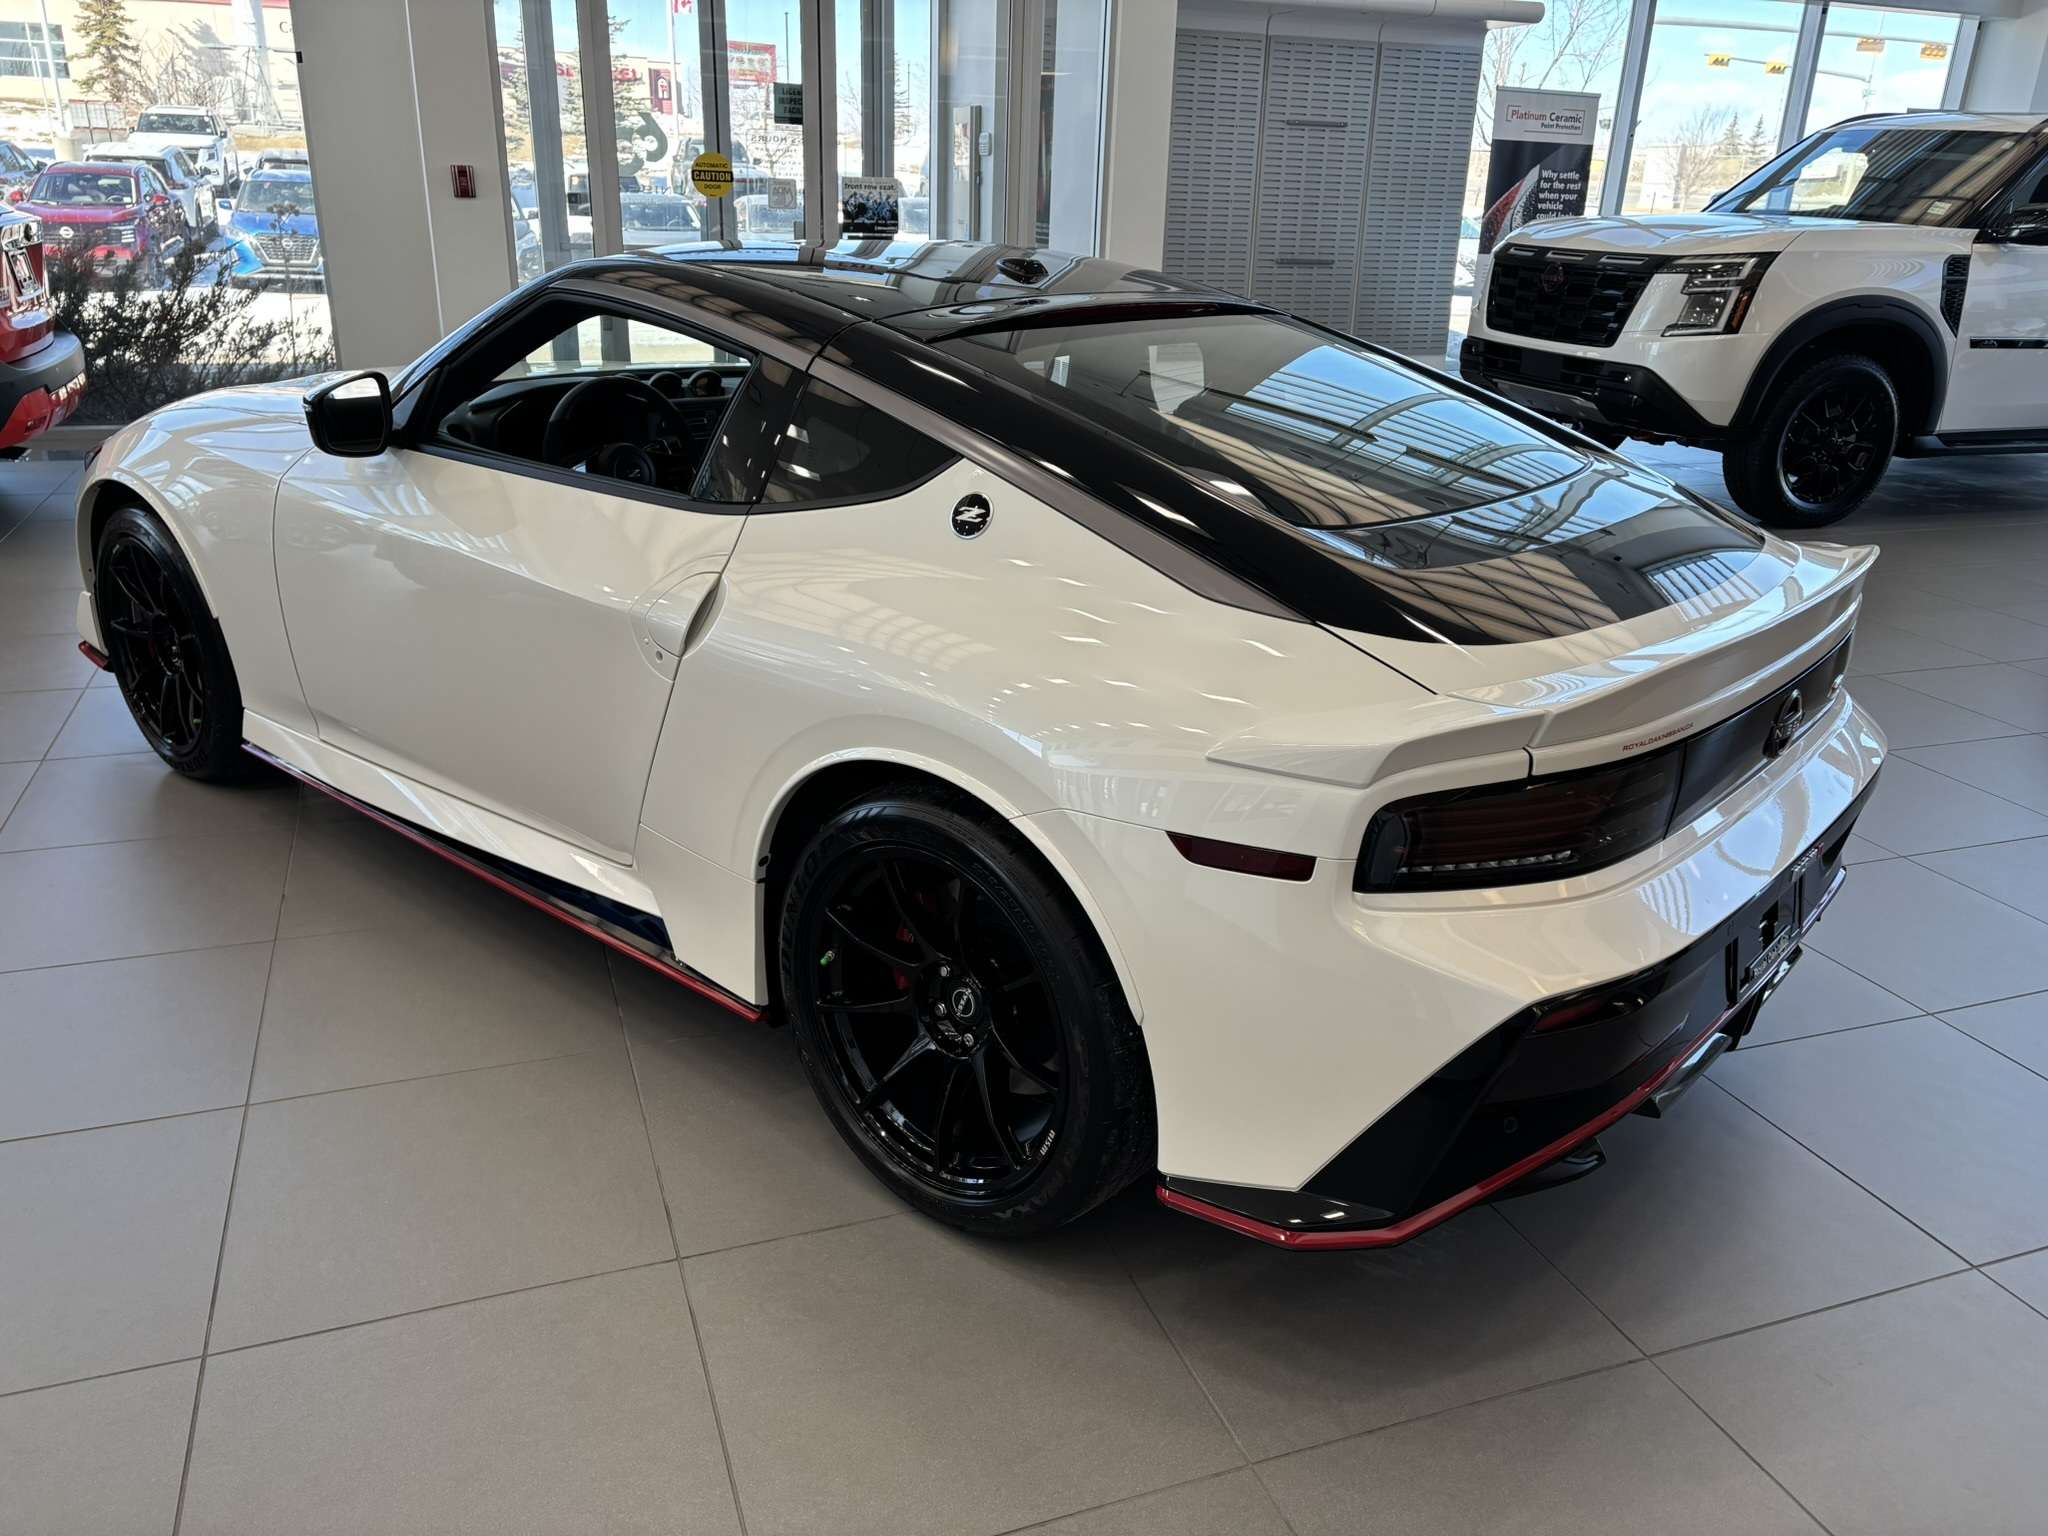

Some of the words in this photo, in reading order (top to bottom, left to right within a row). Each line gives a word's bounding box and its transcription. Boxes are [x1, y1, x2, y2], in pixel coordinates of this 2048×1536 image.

[1511, 109, 1547, 121] Platinum
[1549, 112, 1582, 124] Ceramic
[693, 171, 732, 181] CAUTION
[1542, 169, 1558, 181] Why
[1559, 170, 1580, 180] settle
[1540, 180, 1552, 189] for
[1553, 180, 1566, 190] the
[1566, 181, 1581, 190] rest
[1538, 190, 1560, 200] when
[1560, 193, 1578, 202] your
[1537, 201, 1564, 210] vehicle
